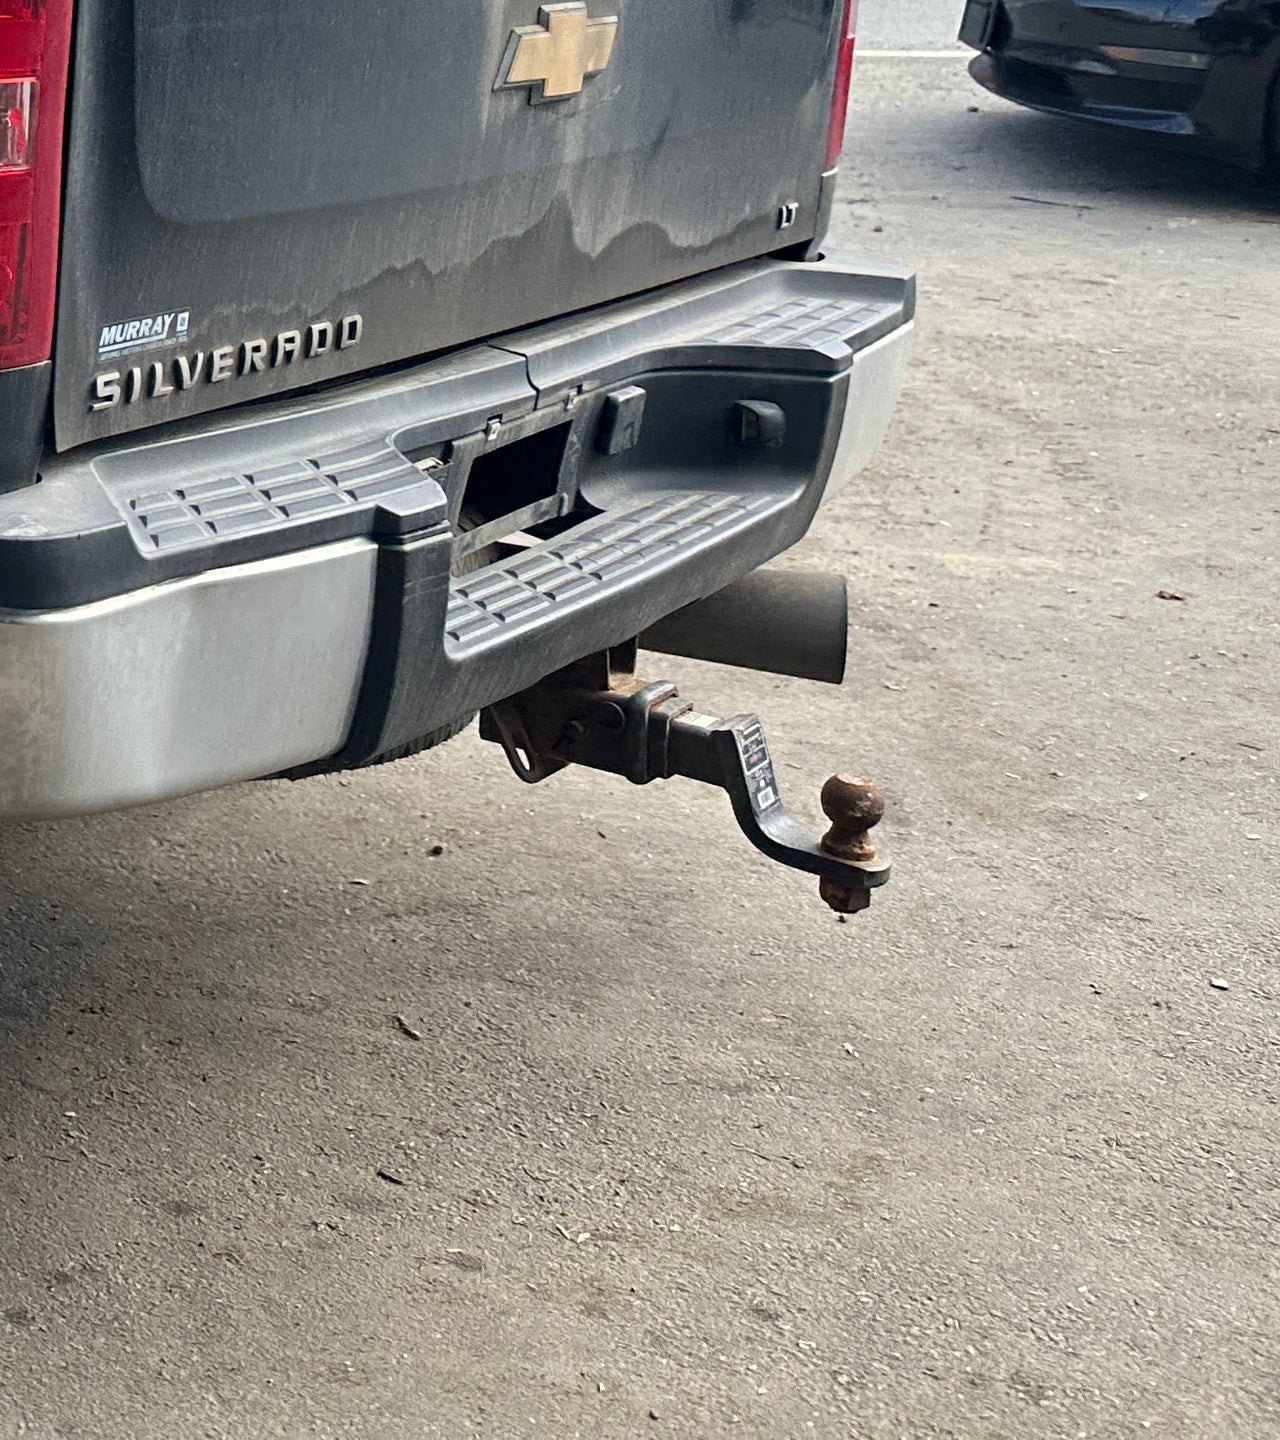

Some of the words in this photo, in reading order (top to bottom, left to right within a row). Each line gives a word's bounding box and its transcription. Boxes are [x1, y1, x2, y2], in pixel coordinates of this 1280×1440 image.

[780, 201, 799, 229] LT
[98, 312, 176, 348] MURRAY
[90, 313, 364, 411] SILVERADO
